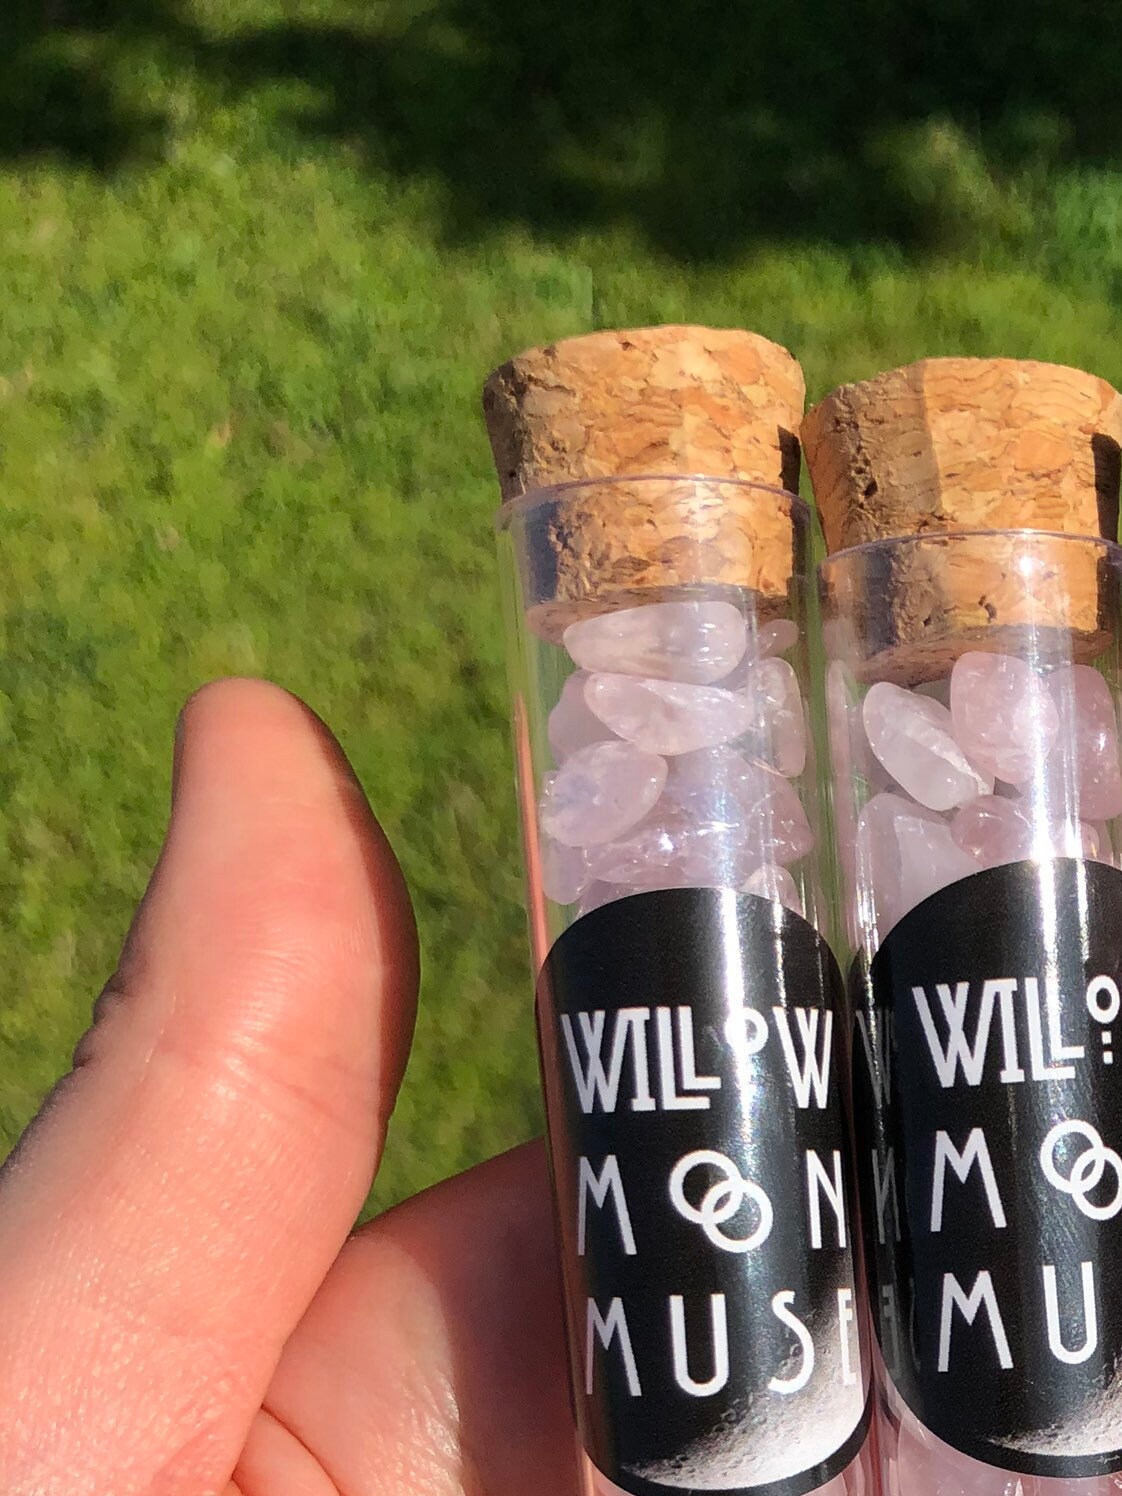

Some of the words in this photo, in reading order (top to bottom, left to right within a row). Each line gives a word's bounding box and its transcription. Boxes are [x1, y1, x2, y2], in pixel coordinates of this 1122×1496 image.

[561, 1006, 833, 1113] WILLOW
[577, 1149, 847, 1256] MOON
[584, 1290, 858, 1397] MUSE
